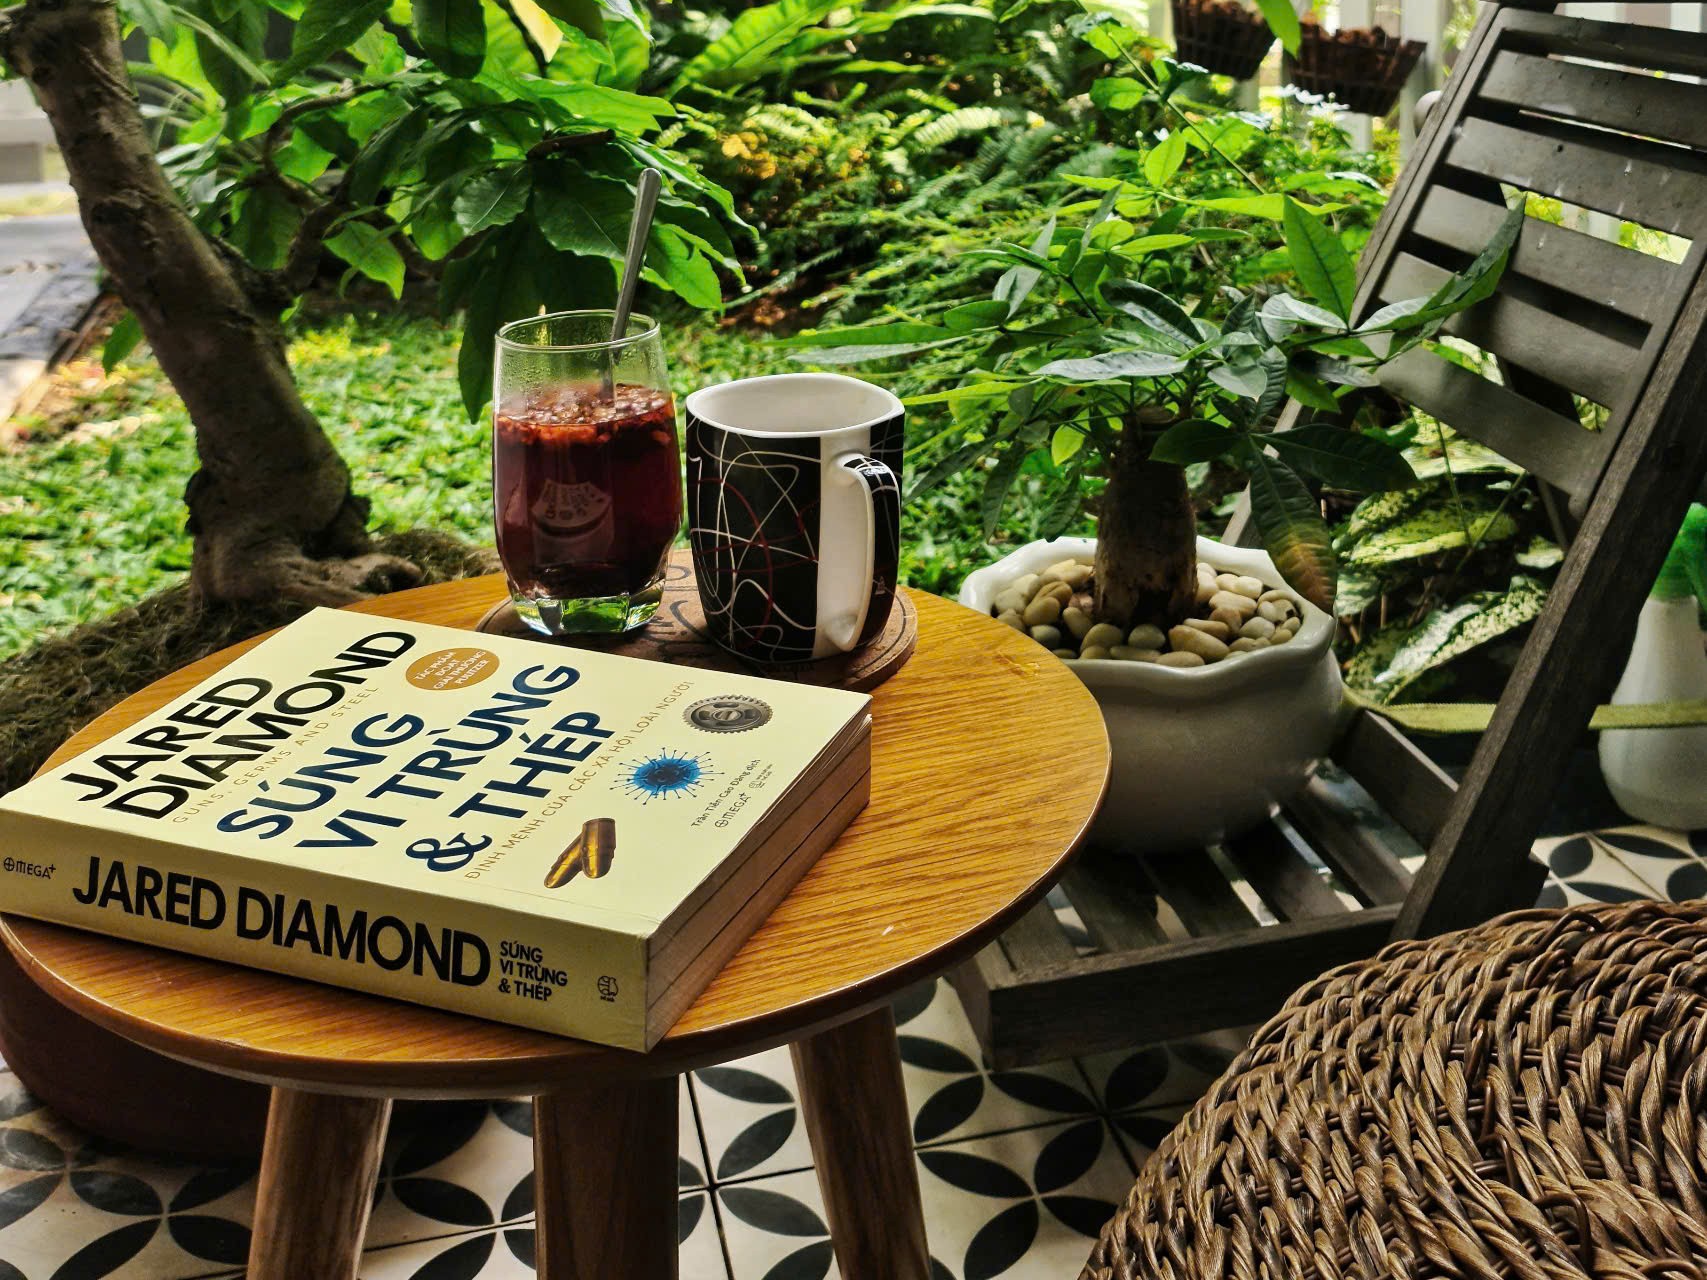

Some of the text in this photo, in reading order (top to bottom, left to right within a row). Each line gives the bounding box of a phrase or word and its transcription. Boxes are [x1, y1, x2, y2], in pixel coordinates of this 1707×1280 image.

[61, 677, 273, 801] JARED
[103, 631, 417, 819] DIAMOND
[217, 712, 425, 840] SÚNG
[234, 750, 292, 786] GERMS
[295, 722, 329, 746] AND
[331, 686, 379, 717] STEEL
[293, 664, 581, 847] VI TRÙNG
[405, 711, 616, 872] & THÉP
[502, 819, 545, 849] MỆNH
[568, 770, 597, 791] CÁC
[719, 786, 734, 798] Cao
[72, 856, 492, 986] JARED DIAMOND
[499, 958, 568, 987] VI TRÙNG
[500, 940, 543, 963] SÚNG
[498, 978, 552, 1001] & THÉP
